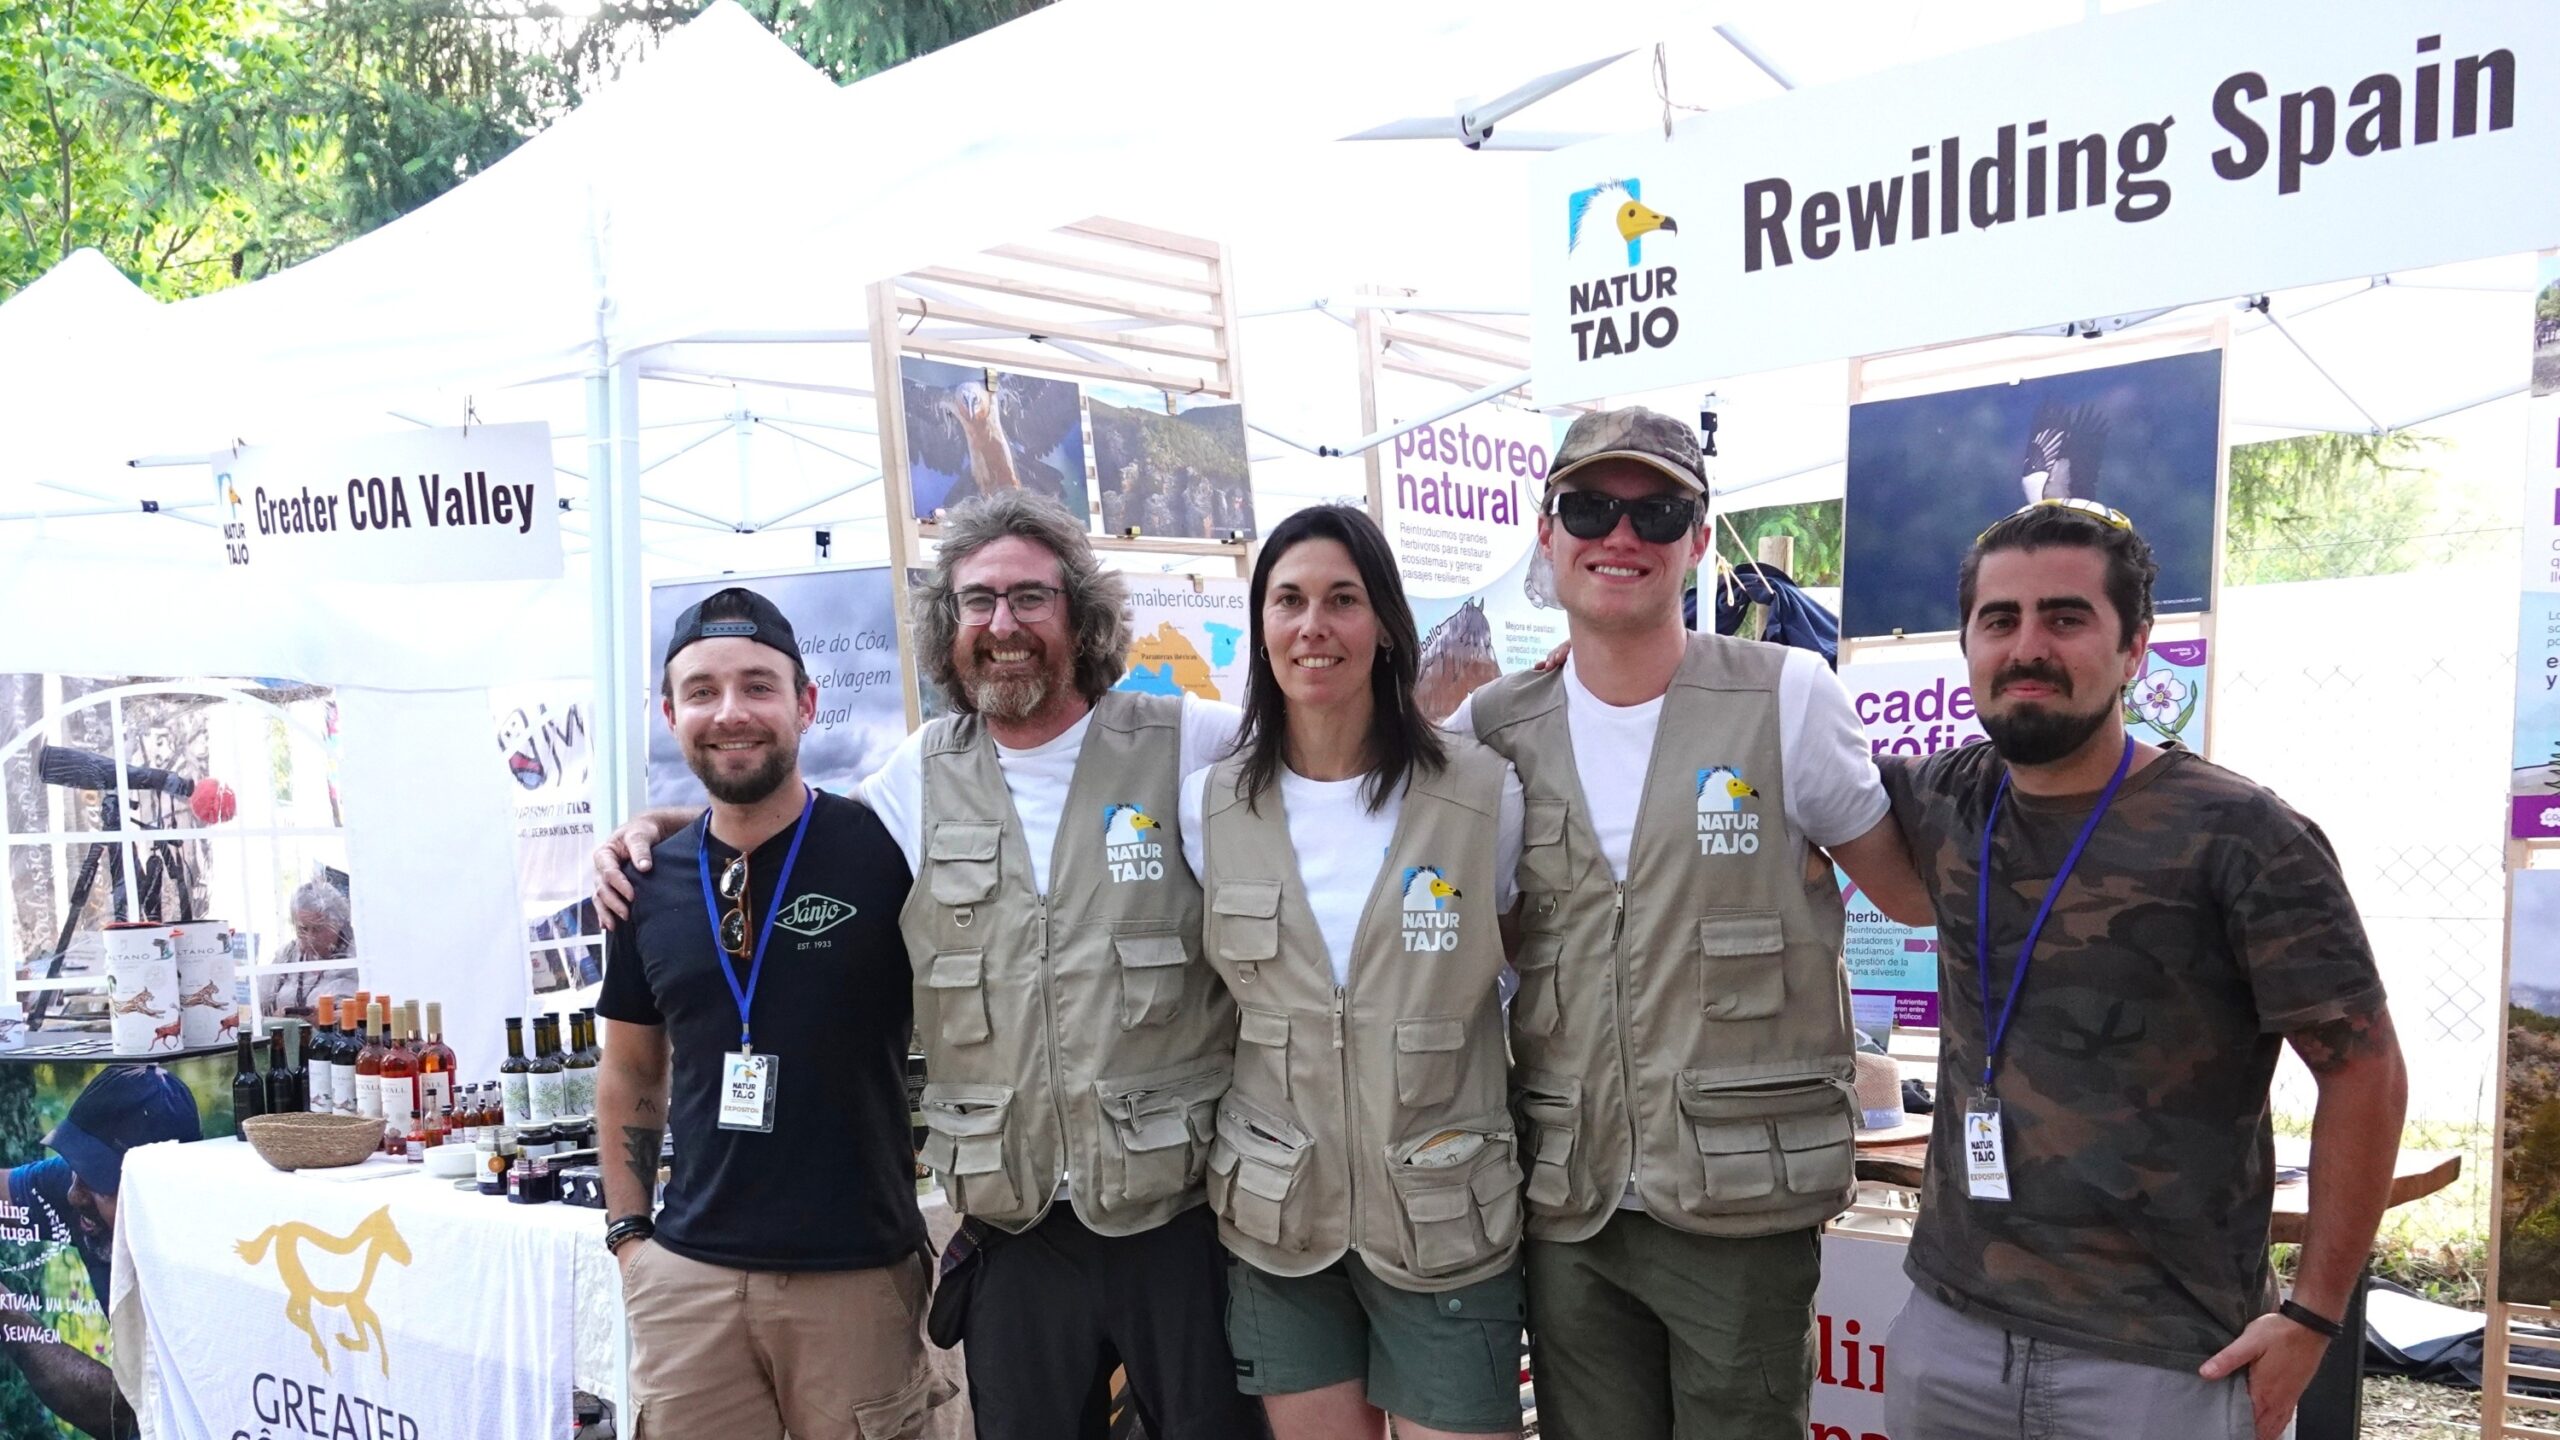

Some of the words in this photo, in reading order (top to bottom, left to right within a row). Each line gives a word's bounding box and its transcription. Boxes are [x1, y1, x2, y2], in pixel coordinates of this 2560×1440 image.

[1745, 115, 2174, 272] Rewilding
[2211, 34, 2516, 195] Spain
[1570, 266, 1677, 315] NATUR
[1571, 306, 1679, 361] TAJO
[1393, 418, 1547, 480] pastoreo
[255, 486, 338, 535] Greater
[348, 476, 412, 531] COA
[418, 471, 534, 534] Valley
[1397, 471, 1519, 526] natural
[223, 523, 246, 540] NATUR
[1400, 522, 1457, 541] Reintroducimos
[1459, 532, 1488, 544] grandes
[226, 543, 249, 565] TAJO
[1442, 544, 1458, 555] para
[1401, 554, 1448, 568] ecosistemas
[829, 632, 850, 653] do
[855, 630, 889, 652] Côa,
[815, 668, 891, 693] selvagem
[1855, 677, 1977, 725] cade
[1871, 724, 1986, 756] rófi
[1697, 813, 1759, 831] NATUR
[1106, 843, 1162, 862] NATUR
[1697, 832, 1759, 856] TAJO
[1108, 860, 1164, 883] TAJO
[783, 895, 841, 931] Sanjo
[1402, 912, 1460, 929] NATUR
[1846, 926, 1914, 935] Reintroducimos
[814, 940, 832, 949] 1933
[1401, 930, 1459, 952] TAJO
[1846, 937, 1892, 946] pastadores
[1895, 938, 1901, 947] y
[1846, 948, 1894, 956] estudiamos
[1855, 957, 1885, 968] gestión
[1888, 958, 1899, 966] de
[1901, 959, 1908, 967] la
[1870, 968, 1906, 977] silvestre
[732, 1082, 756, 1090] NATUR
[732, 1090, 755, 1099] TAJO
[1971, 1141, 1994, 1149] NATUR
[1972, 1151, 1995, 1162] TAJO
[1970, 1173, 2005, 1181] EXPOSITOR
[45, 1296, 62, 1313] UM
[66, 1298, 105, 1316] LUGAR
[3, 1323, 61, 1344] SELVAGEM
